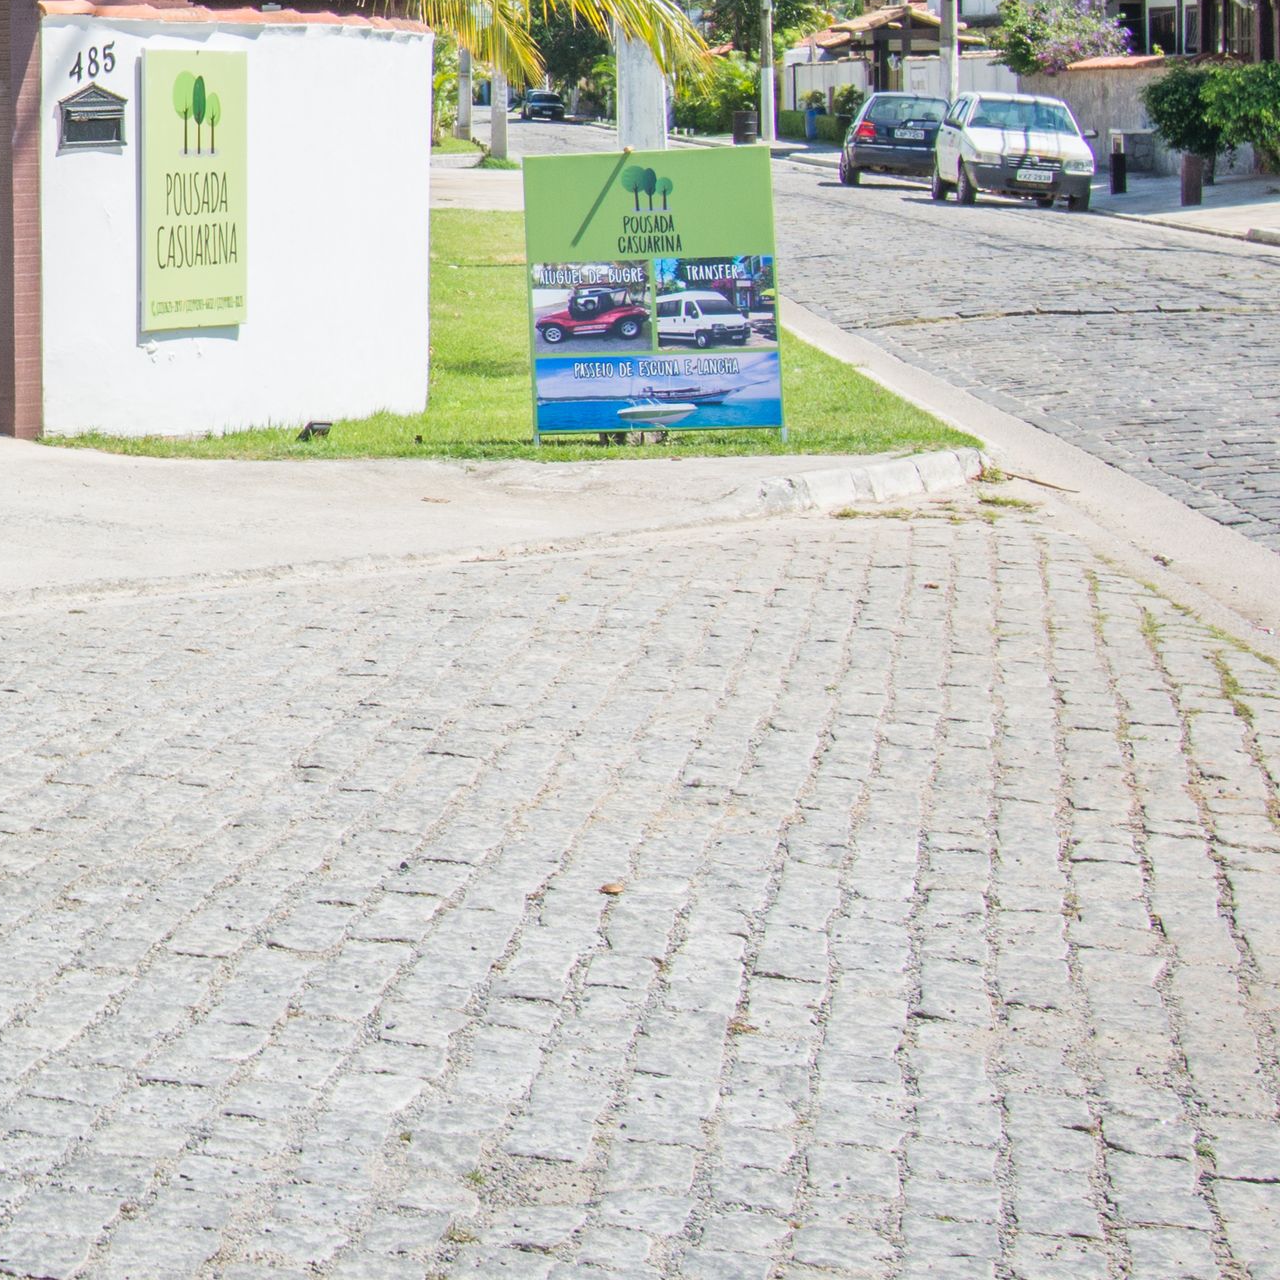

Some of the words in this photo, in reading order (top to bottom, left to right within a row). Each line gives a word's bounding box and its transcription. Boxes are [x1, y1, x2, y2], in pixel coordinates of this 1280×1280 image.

[69, 41, 116, 83] 485
[165, 171, 228, 216] POUSADA
[622, 214, 675, 234] POUSADA
[156, 222, 238, 269] CASUARINA
[617, 234, 683, 254] CASUARINA
[539, 269, 583, 285] ALUGUEL
[587, 269, 602, 284] DE
[608, 267, 645, 283] BUGRE
[686, 264, 739, 280] TRANSFER
[574, 362, 614, 378] PASSEIO
[619, 362, 633, 378] DE
[638, 360, 680, 376] ESCUNA
[684, 359, 692, 376] E
[697, 357, 740, 376] LANCHA
